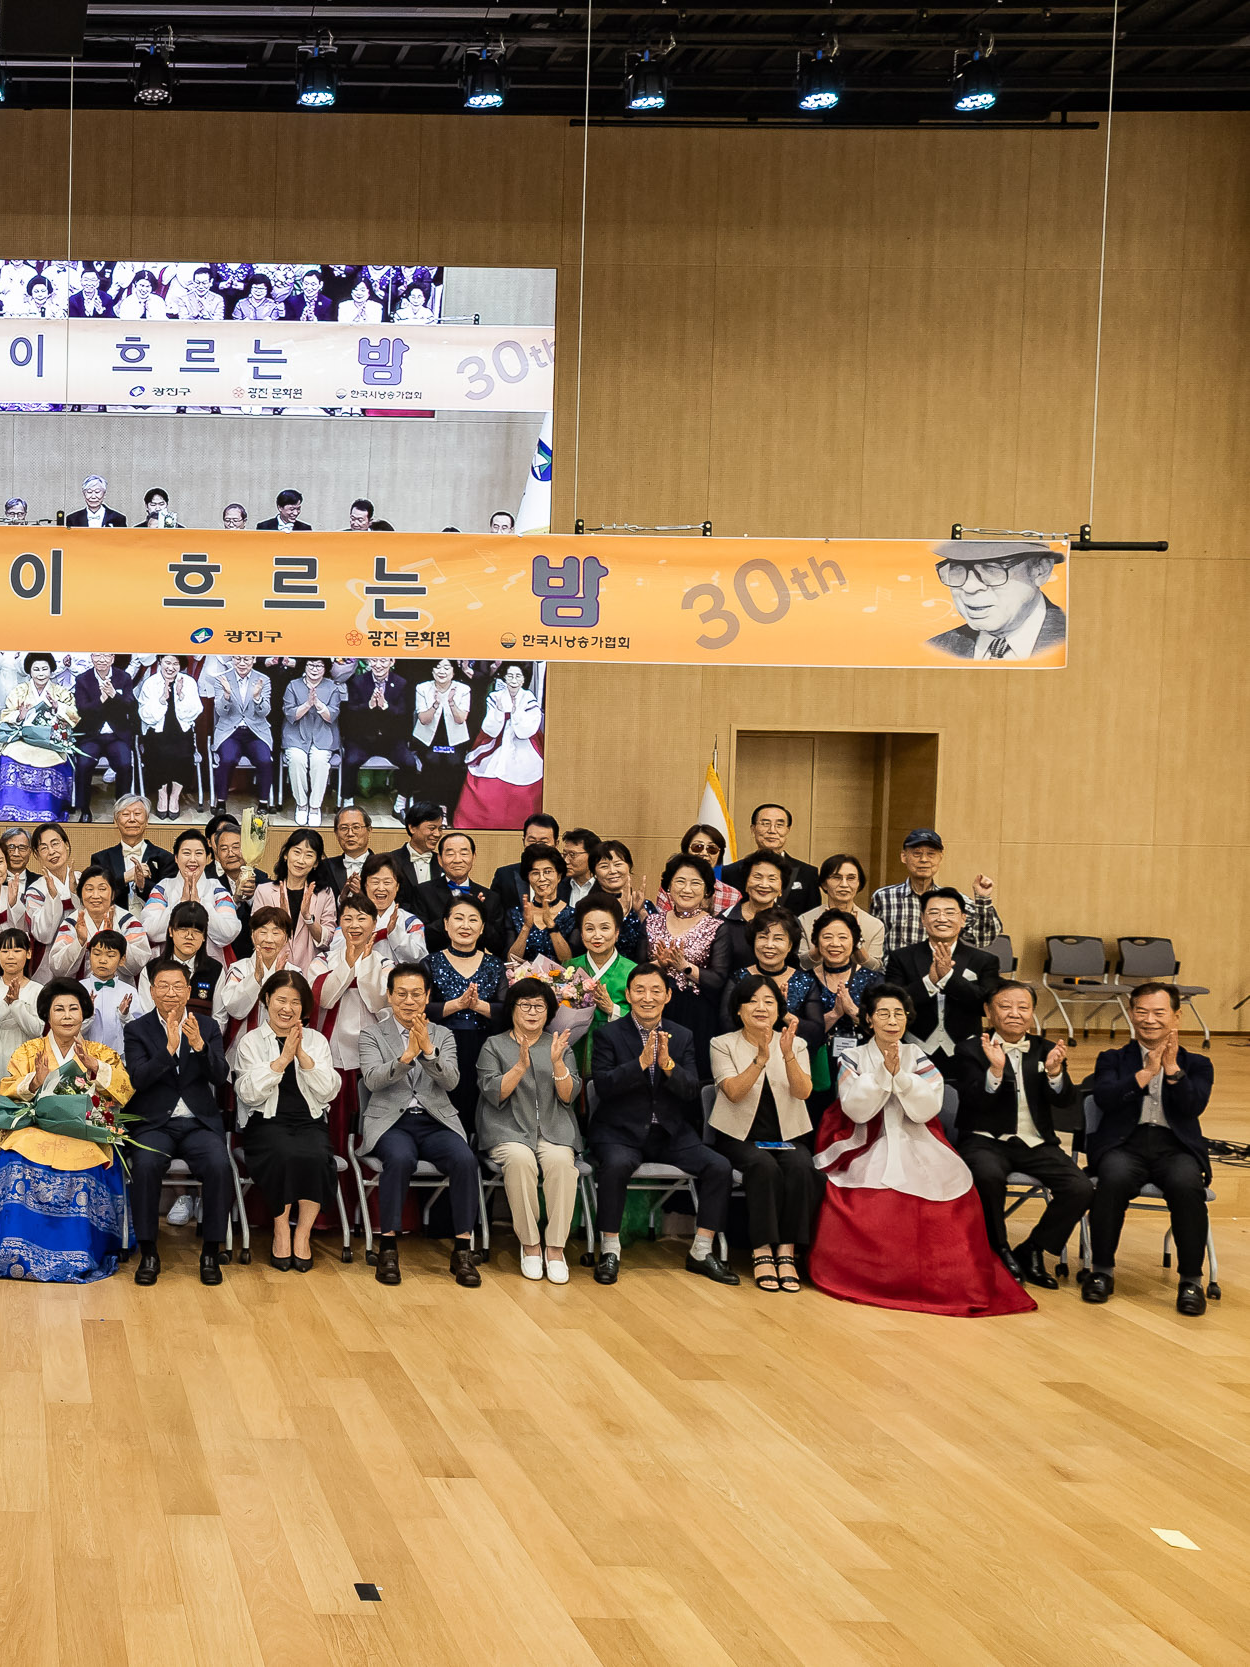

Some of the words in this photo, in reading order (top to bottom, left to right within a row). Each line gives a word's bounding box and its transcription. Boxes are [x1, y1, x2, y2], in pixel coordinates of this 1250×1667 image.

[357, 336, 411, 386] 밤
[152, 387, 192, 397] 광진구
[247, 387, 268, 399] 광진
[271, 387, 303, 400] 문화원
[350, 389, 423, 400] 한국시낭송가협회
[531, 554, 610, 628] 밤
[681, 555, 847, 650] 30th
[223, 630, 283, 643] 광진구
[367, 630, 399, 647] 광진
[404, 631, 451, 648] 문화원
[522, 634, 631, 649] 한국시낭송가협회
